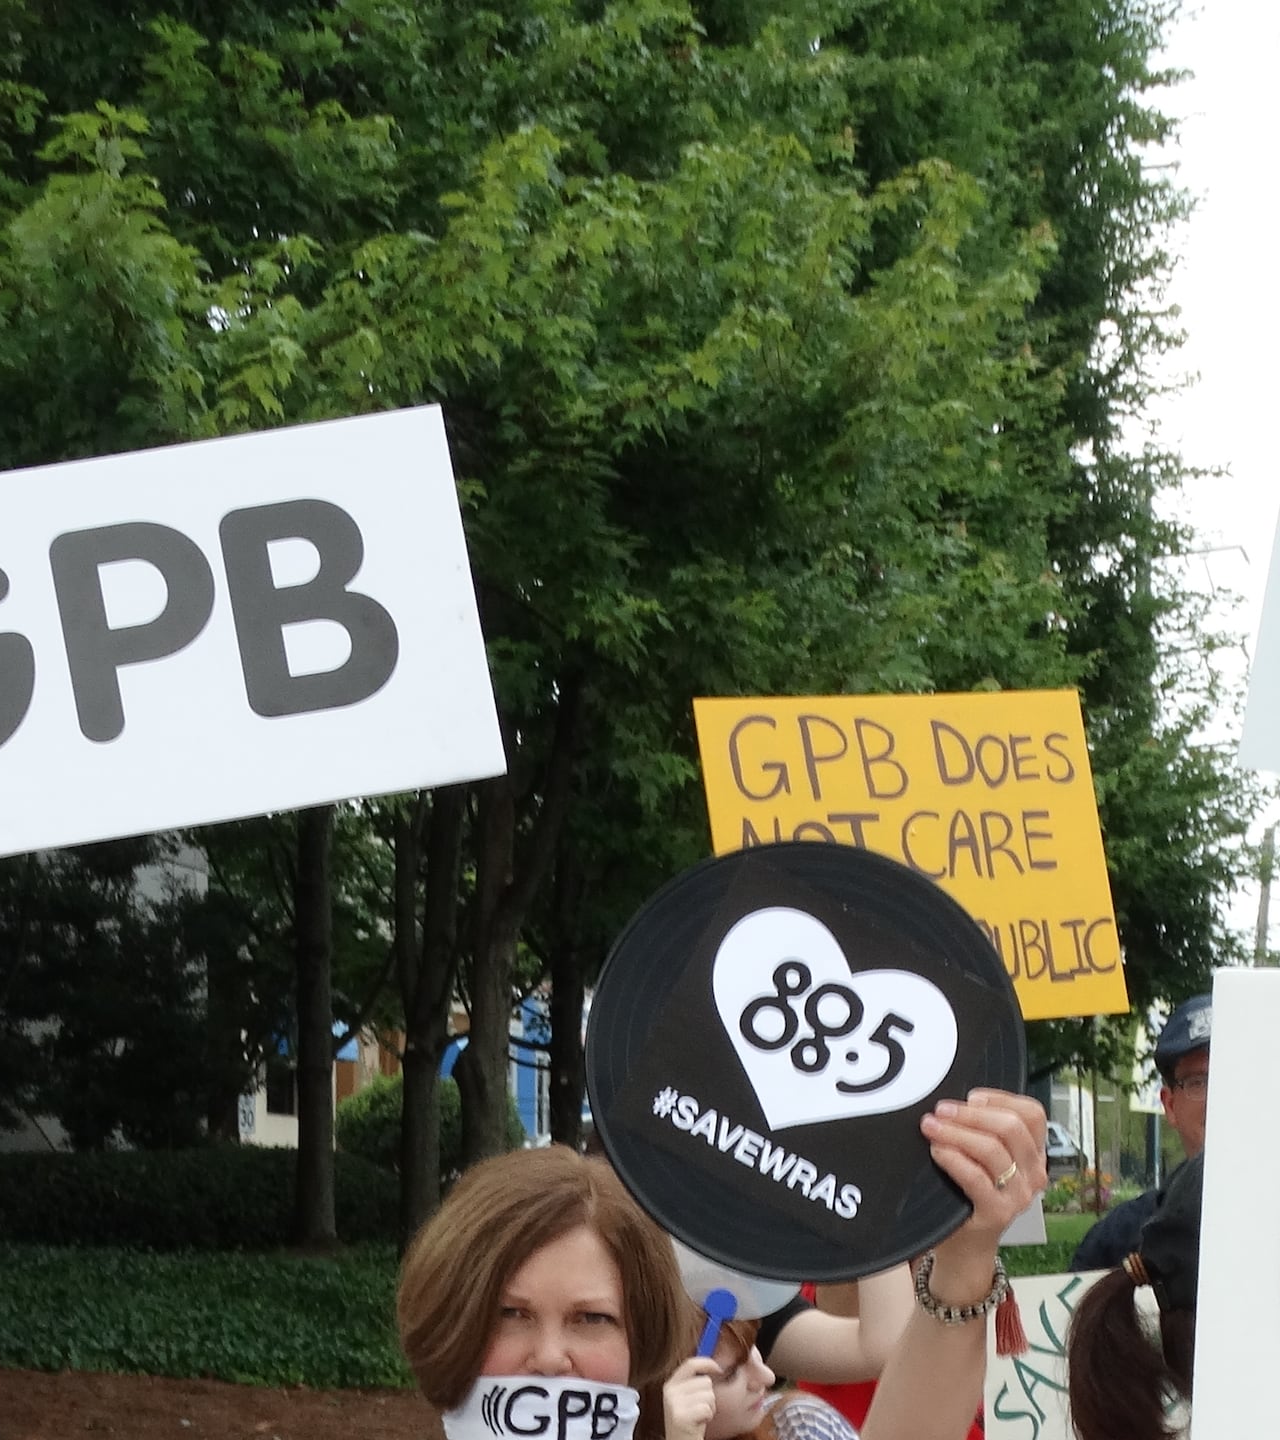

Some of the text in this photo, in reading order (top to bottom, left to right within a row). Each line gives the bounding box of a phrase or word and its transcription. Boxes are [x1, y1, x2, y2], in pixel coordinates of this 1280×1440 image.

[728, 715, 1075, 802] GPB DOES
[902, 810, 1058, 880] CARE
[739, 960, 915, 1093] 88.5
[652, 1086, 862, 1219] #SAVEWRAS
